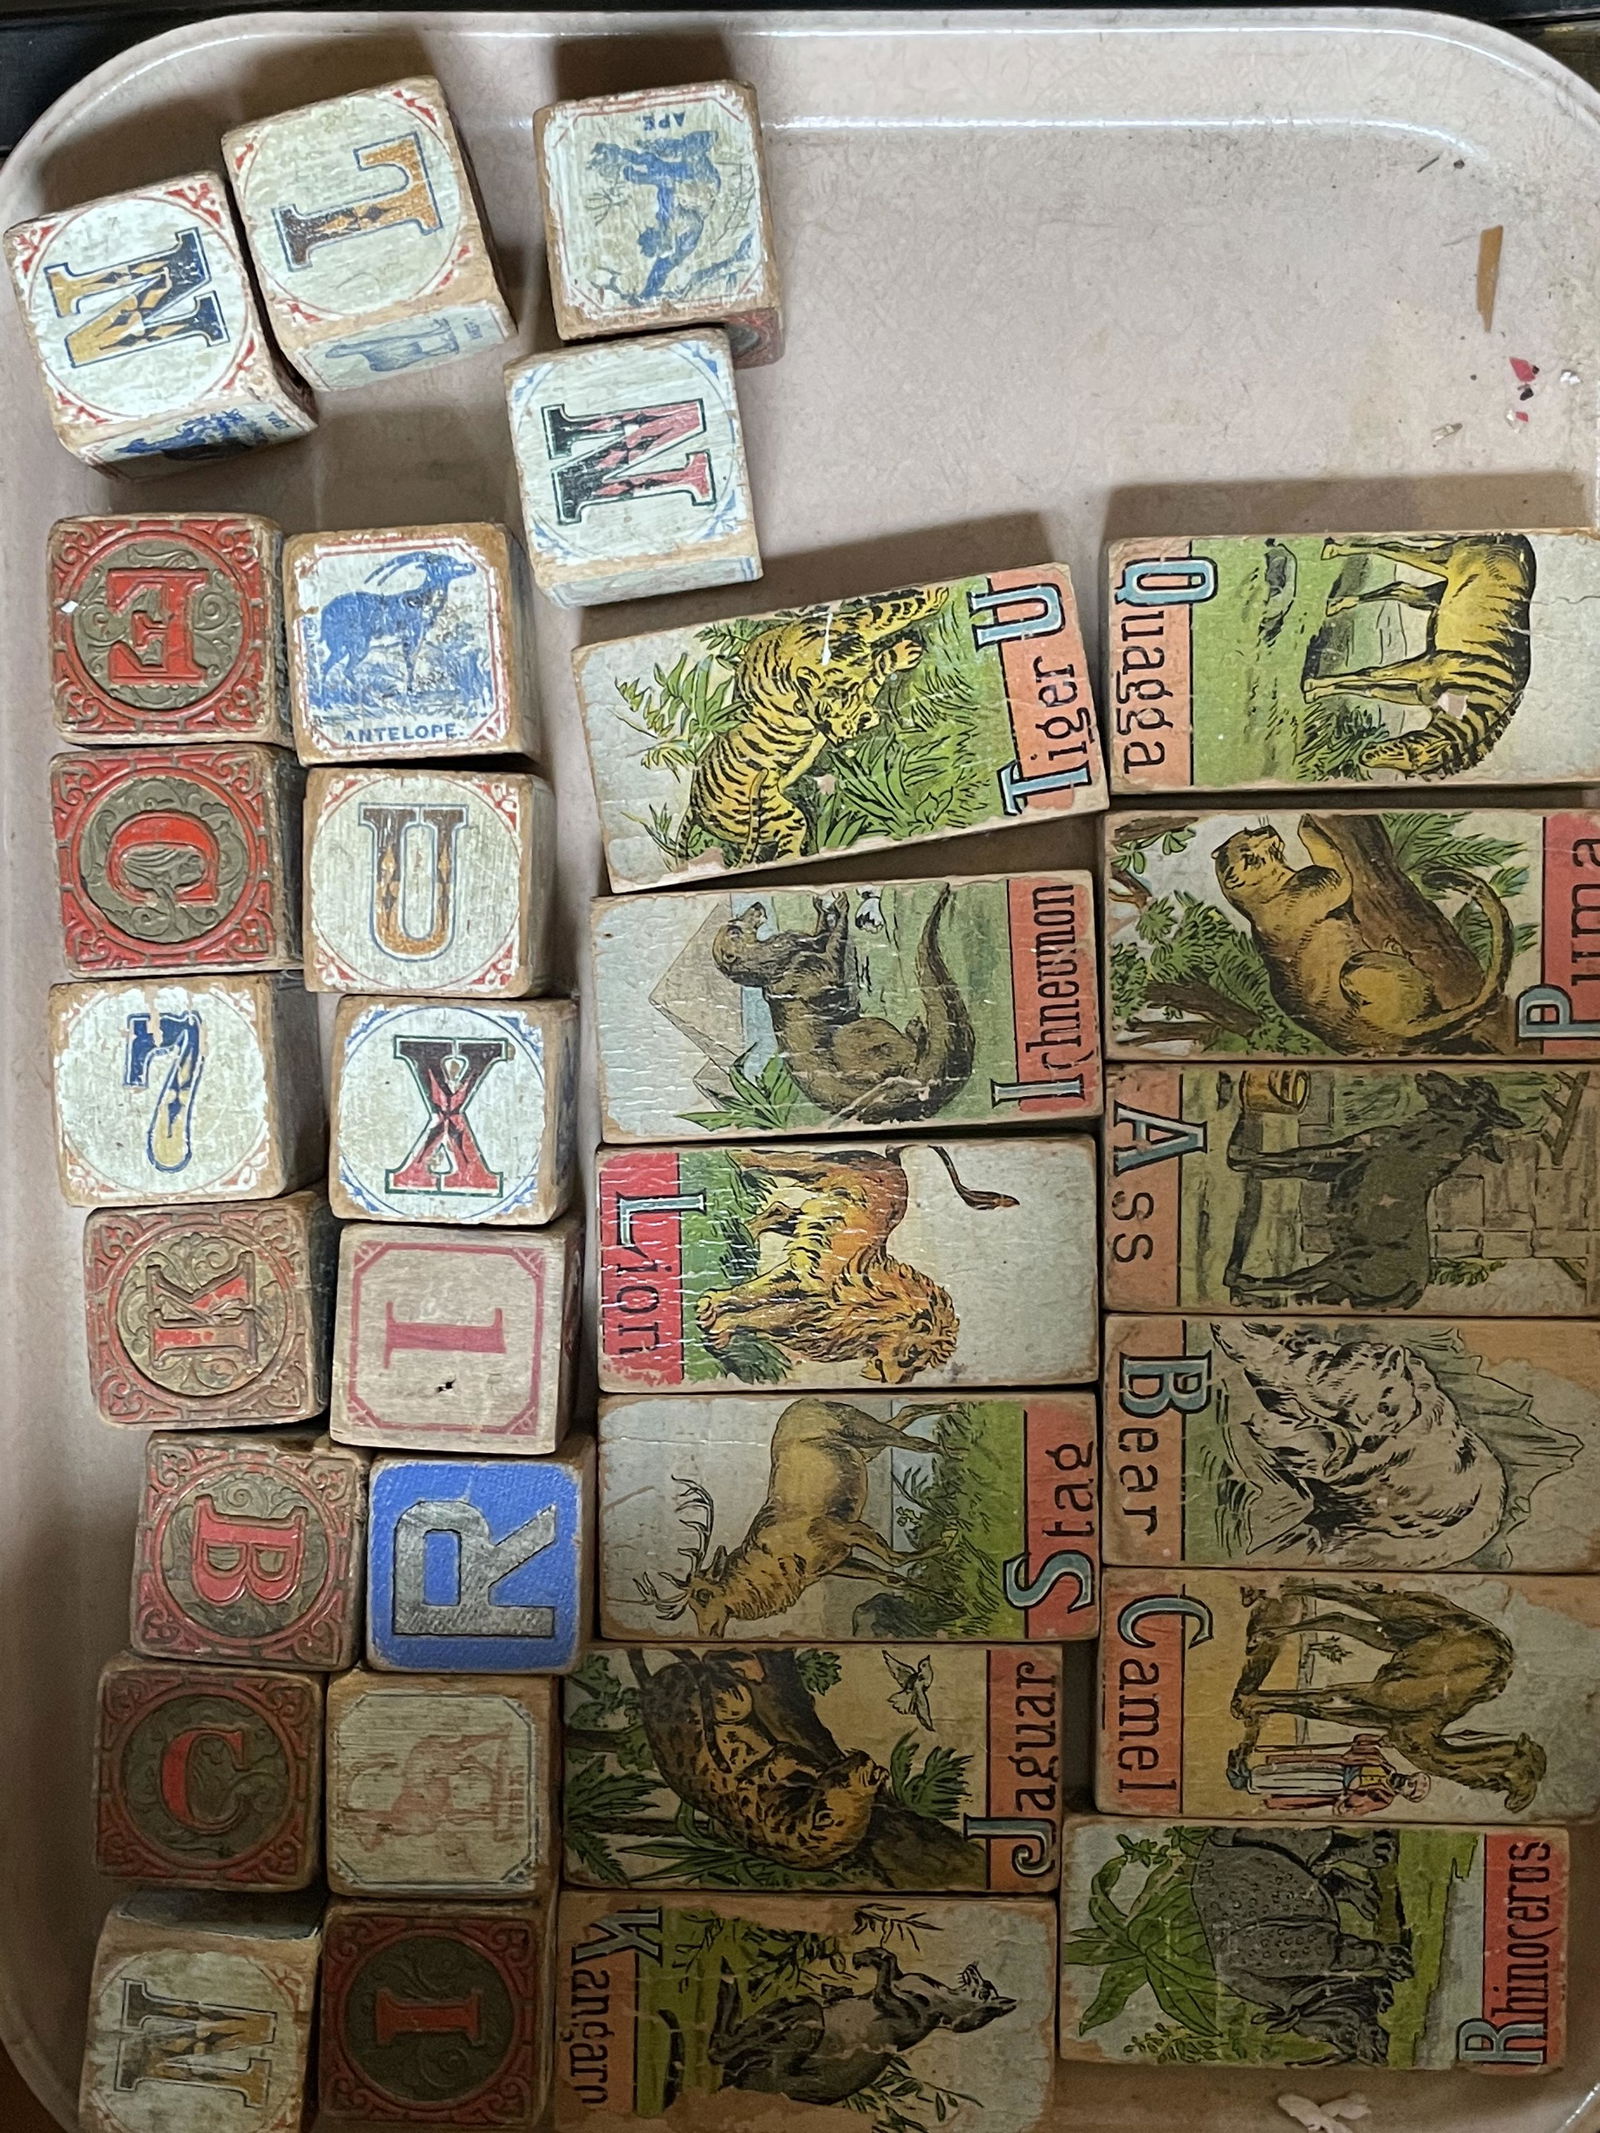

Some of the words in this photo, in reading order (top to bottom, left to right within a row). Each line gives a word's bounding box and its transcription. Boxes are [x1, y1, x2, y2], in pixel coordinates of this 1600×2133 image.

[271, 131, 443, 273] L
[44, 228, 231, 369] N
[541, 397, 717, 526] N
[106, 568, 211, 687] E
[967, 581, 1064, 652] U
[1114, 557, 1218, 776] Quagga
[344, 723, 466, 742] ANTELOPE.
[997, 655, 1094, 817] Tiger
[107, 810, 219, 906] C
[358, 801, 469, 962] U
[988, 882, 1088, 1106] Ichneumon
[1515, 837, 1600, 1047] Puma
[124, 1009, 204, 1173] 7
[384, 1036, 509, 1197] X
[1113, 1104, 1210, 1265] Ass
[146, 1250, 258, 1371] K
[612, 1191, 708, 1360] Lion
[1118, 1352, 1215, 1540] Bear
[192, 1495, 309, 1608] B
[393, 1499, 557, 1637] R
[1004, 1440, 1096, 1616] Stag
[963, 1660, 1060, 1879] Jaguar
[1117, 1593, 1214, 1796] Camel
[164, 1725, 242, 1833] C
[377, 1994, 483, 2045] I
[1459, 1840, 1558, 2066] Rhinoceros
[114, 1977, 279, 2114] N
